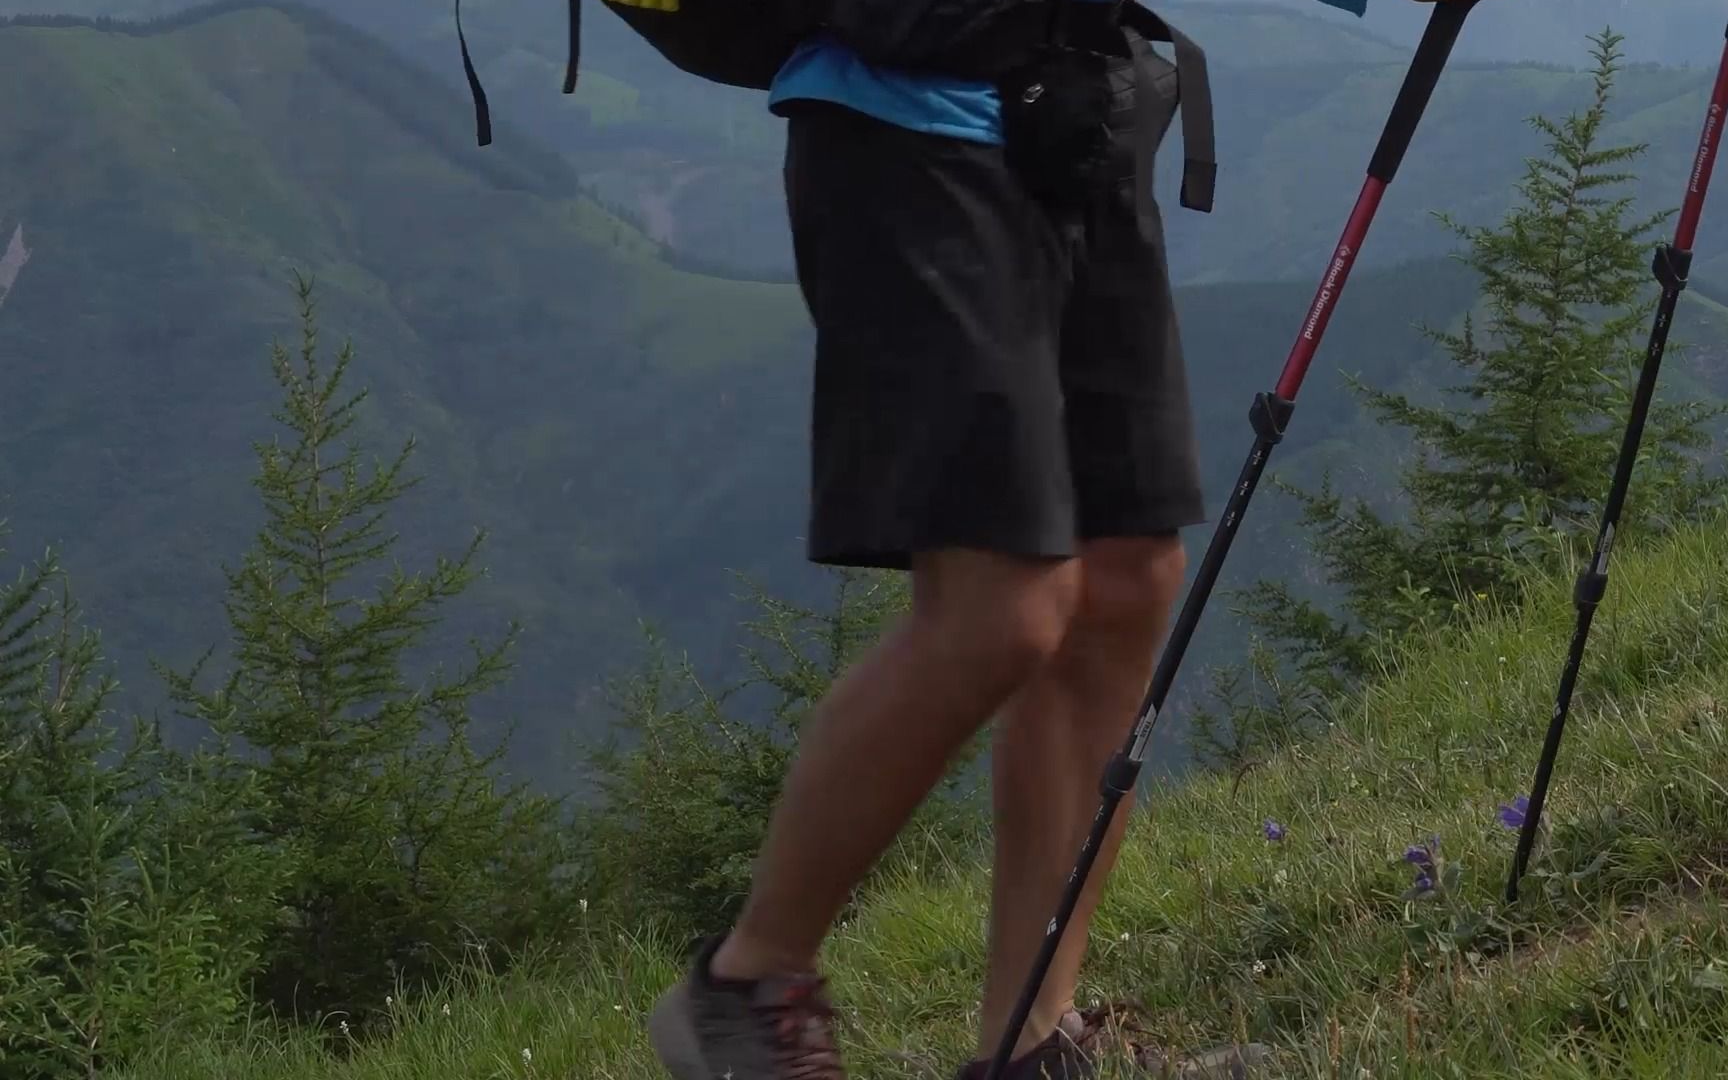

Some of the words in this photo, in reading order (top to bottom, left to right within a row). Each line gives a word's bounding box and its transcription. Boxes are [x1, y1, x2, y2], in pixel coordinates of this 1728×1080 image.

[1690, 146, 1709, 193] Diamond
[1325, 259, 1345, 289] Black
[1304, 290, 1331, 340] Diamond
